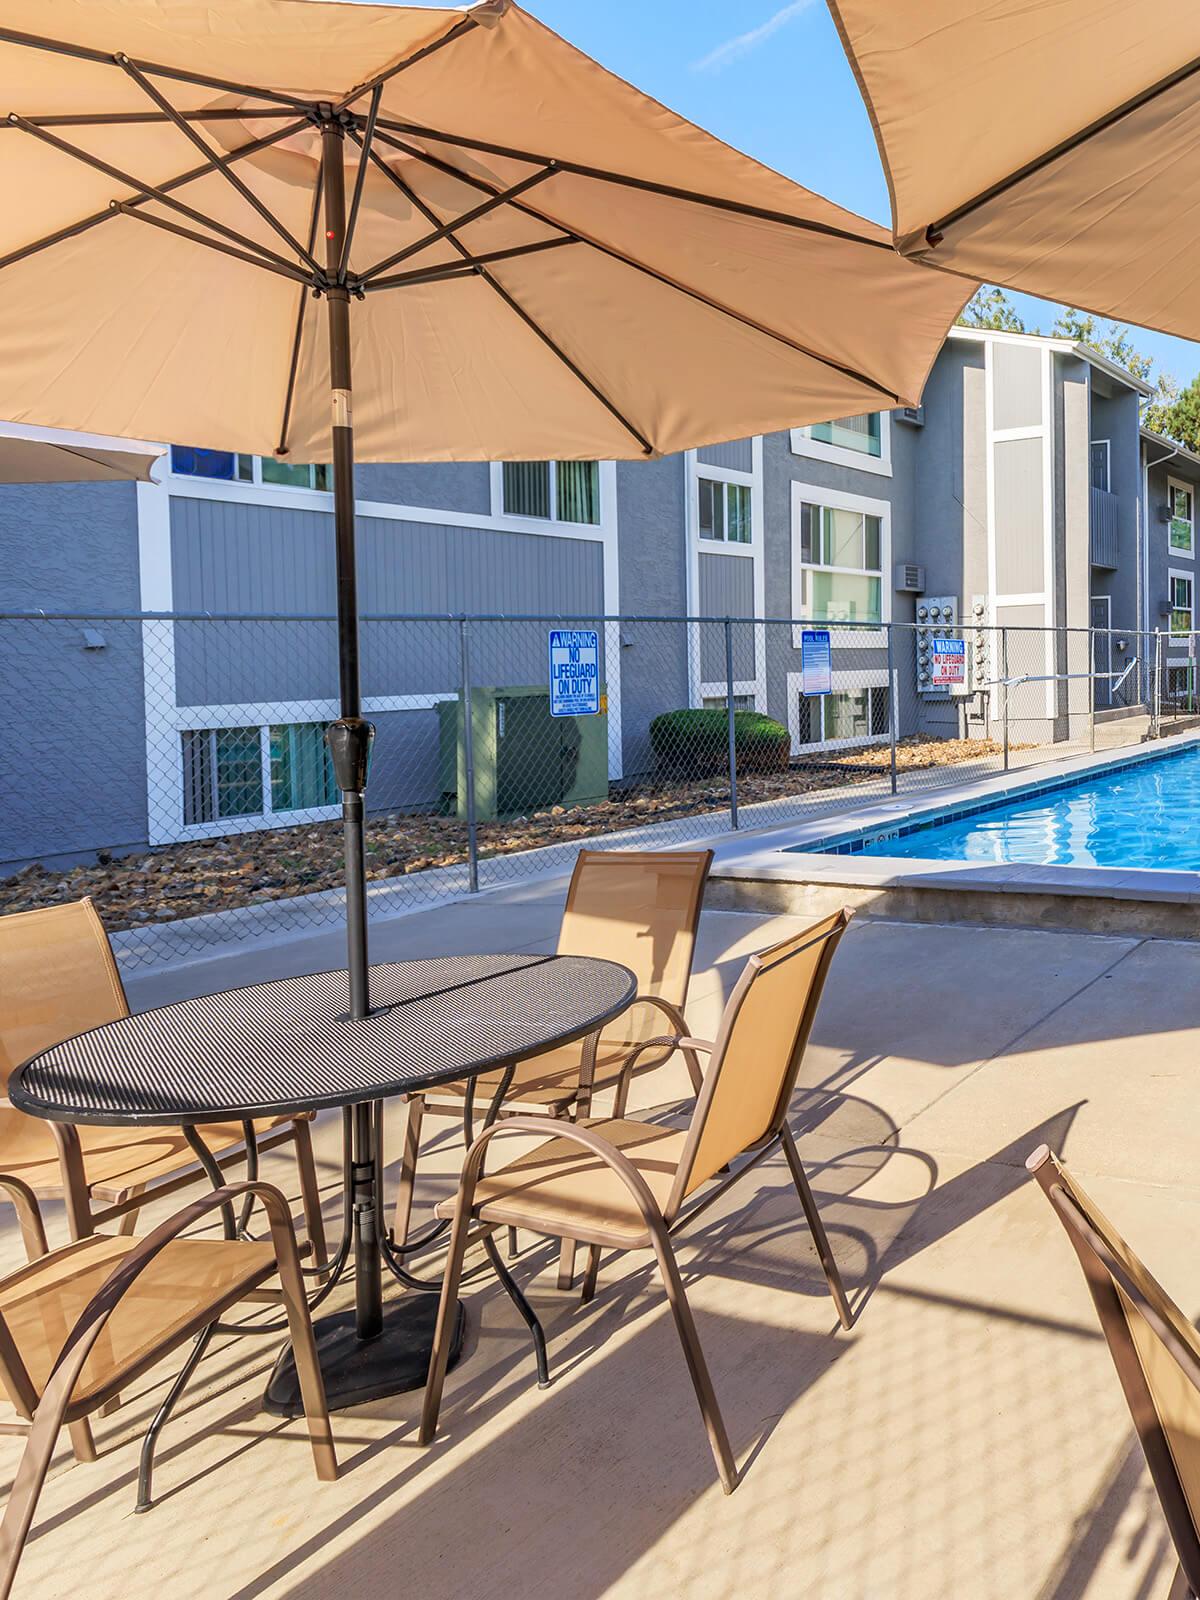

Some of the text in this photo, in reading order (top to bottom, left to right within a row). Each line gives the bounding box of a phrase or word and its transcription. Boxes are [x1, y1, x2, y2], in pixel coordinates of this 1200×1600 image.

[560, 632, 596, 648] WARNING
[936, 640, 963, 653] WARNING
[569, 648, 580, 663] NO
[934, 654, 965, 664] NO LIFEGUARD
[553, 664, 596, 679] LIFEGUARD
[941, 666, 960, 675] ON DUTY
[558, 679, 592, 694] ON DUTY
